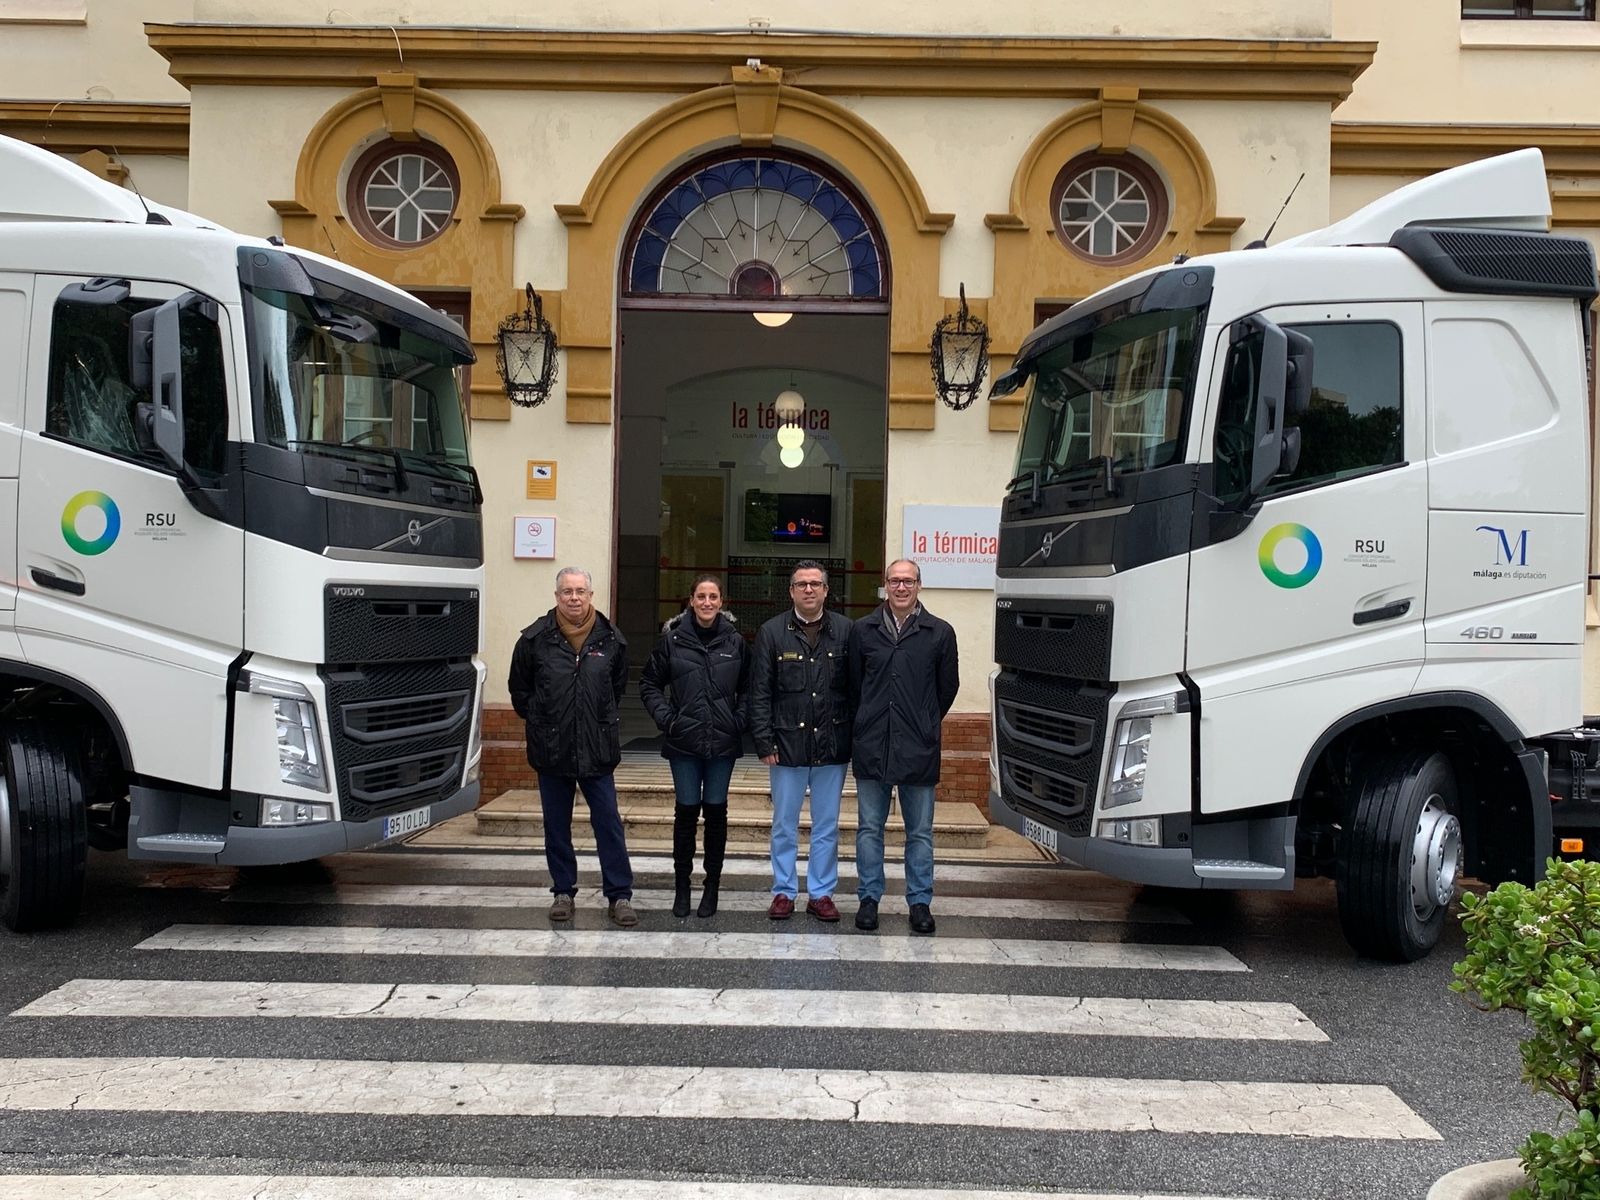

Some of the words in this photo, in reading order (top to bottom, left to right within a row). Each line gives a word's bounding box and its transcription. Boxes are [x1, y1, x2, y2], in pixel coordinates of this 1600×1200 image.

[732, 401, 748, 429] la
[756, 401, 830, 430] térmica
[145, 512, 176, 527] RSU
[913, 530, 927, 554] la
[934, 530, 997, 555] térmica
[1355, 539, 1385, 553] RSU
[332, 587, 366, 597] VOLVO
[1460, 626, 1504, 640] 460
